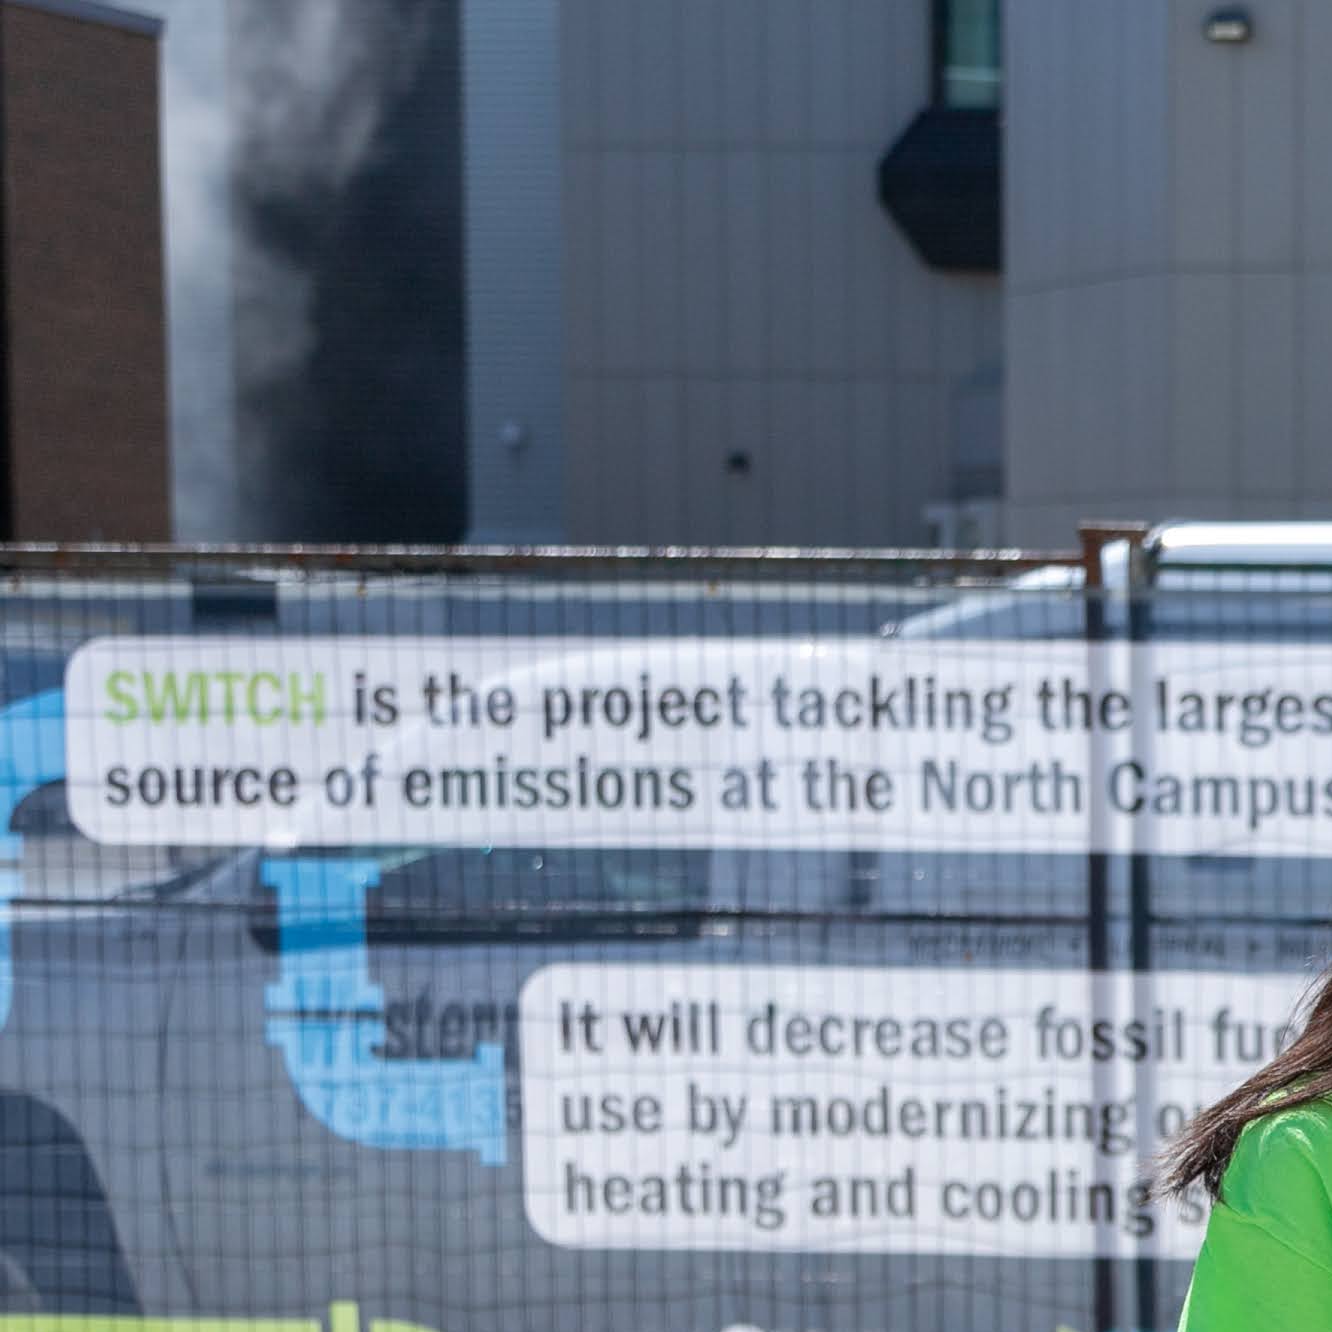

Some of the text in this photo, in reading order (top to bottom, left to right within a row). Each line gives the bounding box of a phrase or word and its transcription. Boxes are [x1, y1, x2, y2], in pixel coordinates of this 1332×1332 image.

[103, 672, 326, 727] SWITCH
[354, 674, 398, 727] is
[423, 675, 515, 727] the
[542, 676, 748, 740] project
[772, 676, 1013, 743] tackling
[1038, 678, 1133, 732] the
[105, 762, 296, 807] source
[326, 754, 381, 807] of
[405, 757, 695, 810] emissions
[724, 762, 778, 811] at
[803, 760, 892, 811] the
[922, 761, 1082, 813] North
[559, 1002, 602, 1053] It
[623, 1001, 719, 1055] will
[746, 1003, 1009, 1058] decrease
[1036, 1005, 1184, 1062] fossil
[562, 1088, 660, 1134] use
[690, 1084, 749, 1148] by
[772, 1091, 1134, 1155] modernizing
[565, 1163, 786, 1229] heating
[811, 1167, 915, 1223] and
[943, 1170, 1156, 1238] cooling
